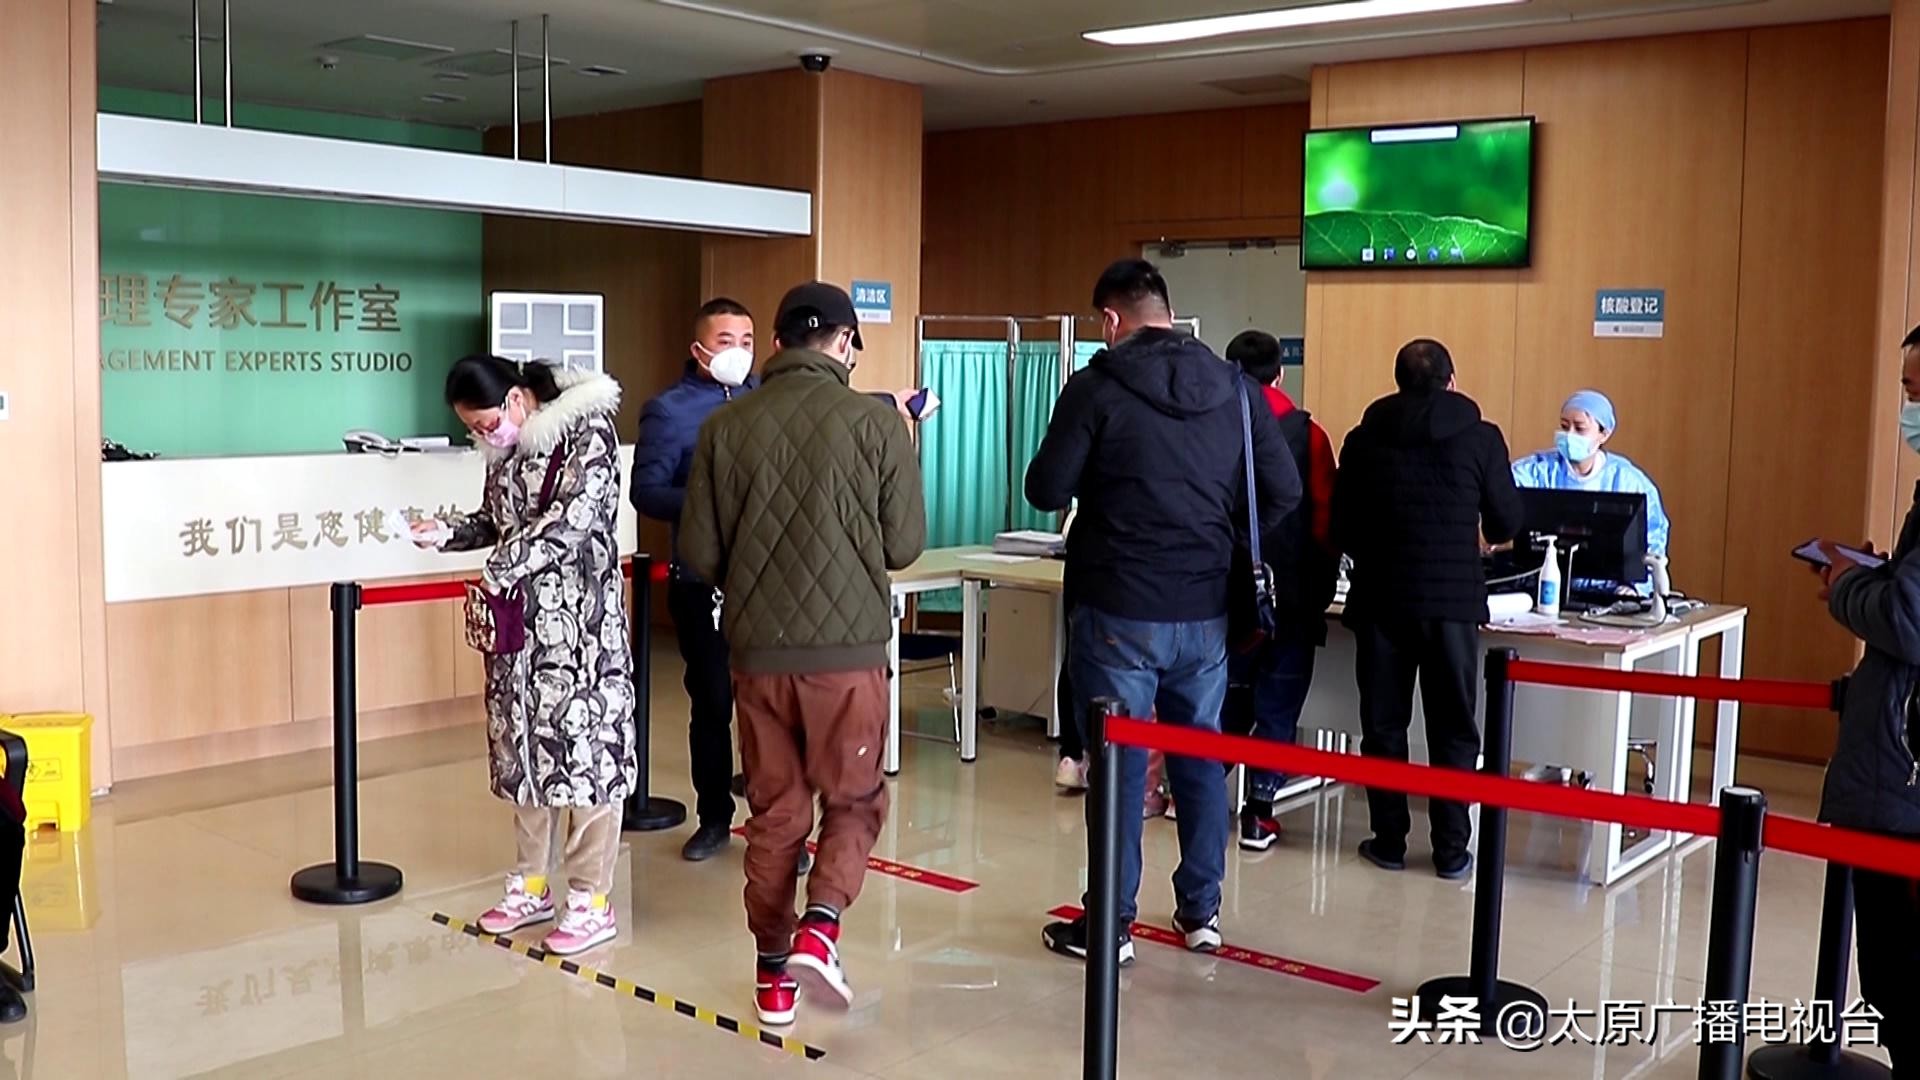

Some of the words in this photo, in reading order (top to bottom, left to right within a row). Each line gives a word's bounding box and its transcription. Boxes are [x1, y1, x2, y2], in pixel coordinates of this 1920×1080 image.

[99, 273, 401, 332] 理专家工作室
[1601, 296, 1658, 314] 核酸登记
[225, 351, 323, 372] EXPERTS
[330, 352, 413, 373] STUDIO
